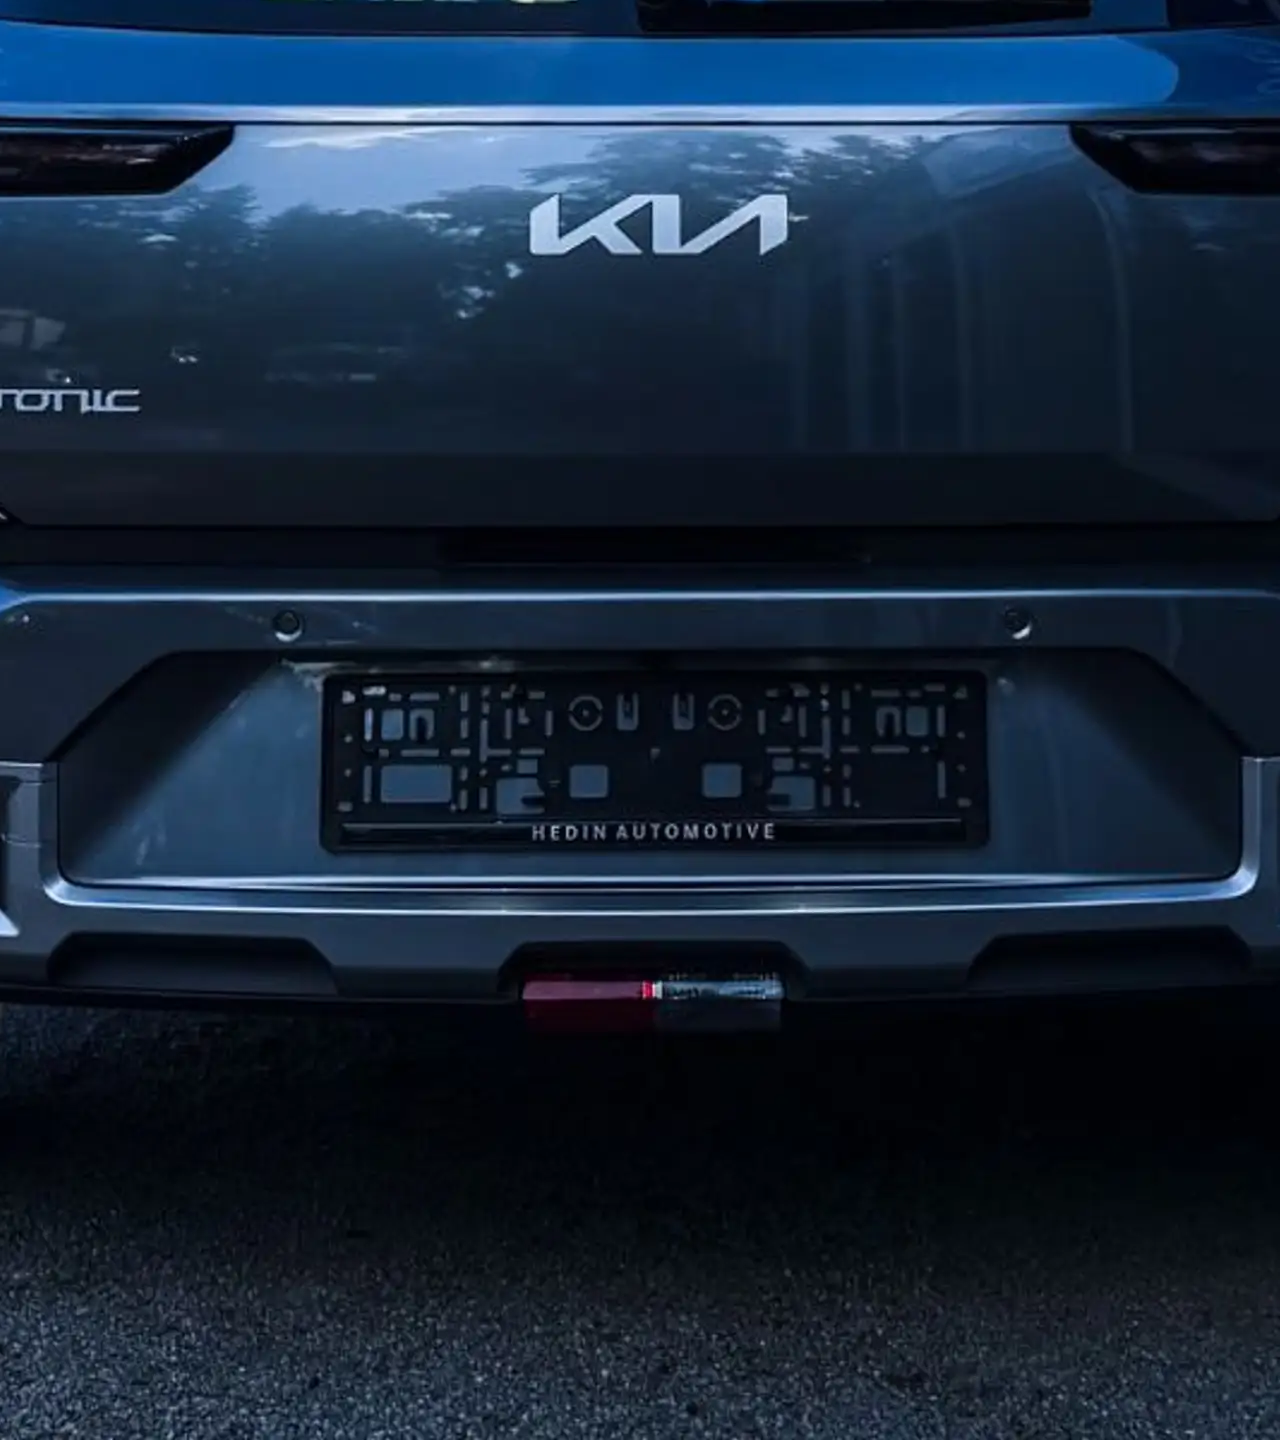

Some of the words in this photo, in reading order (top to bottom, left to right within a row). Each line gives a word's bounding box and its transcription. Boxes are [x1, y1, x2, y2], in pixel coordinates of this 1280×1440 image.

[529, 193, 788, 256] KIA
[531, 824, 607, 841] HEDIN
[615, 822, 776, 841] AUTOMOTIVE
